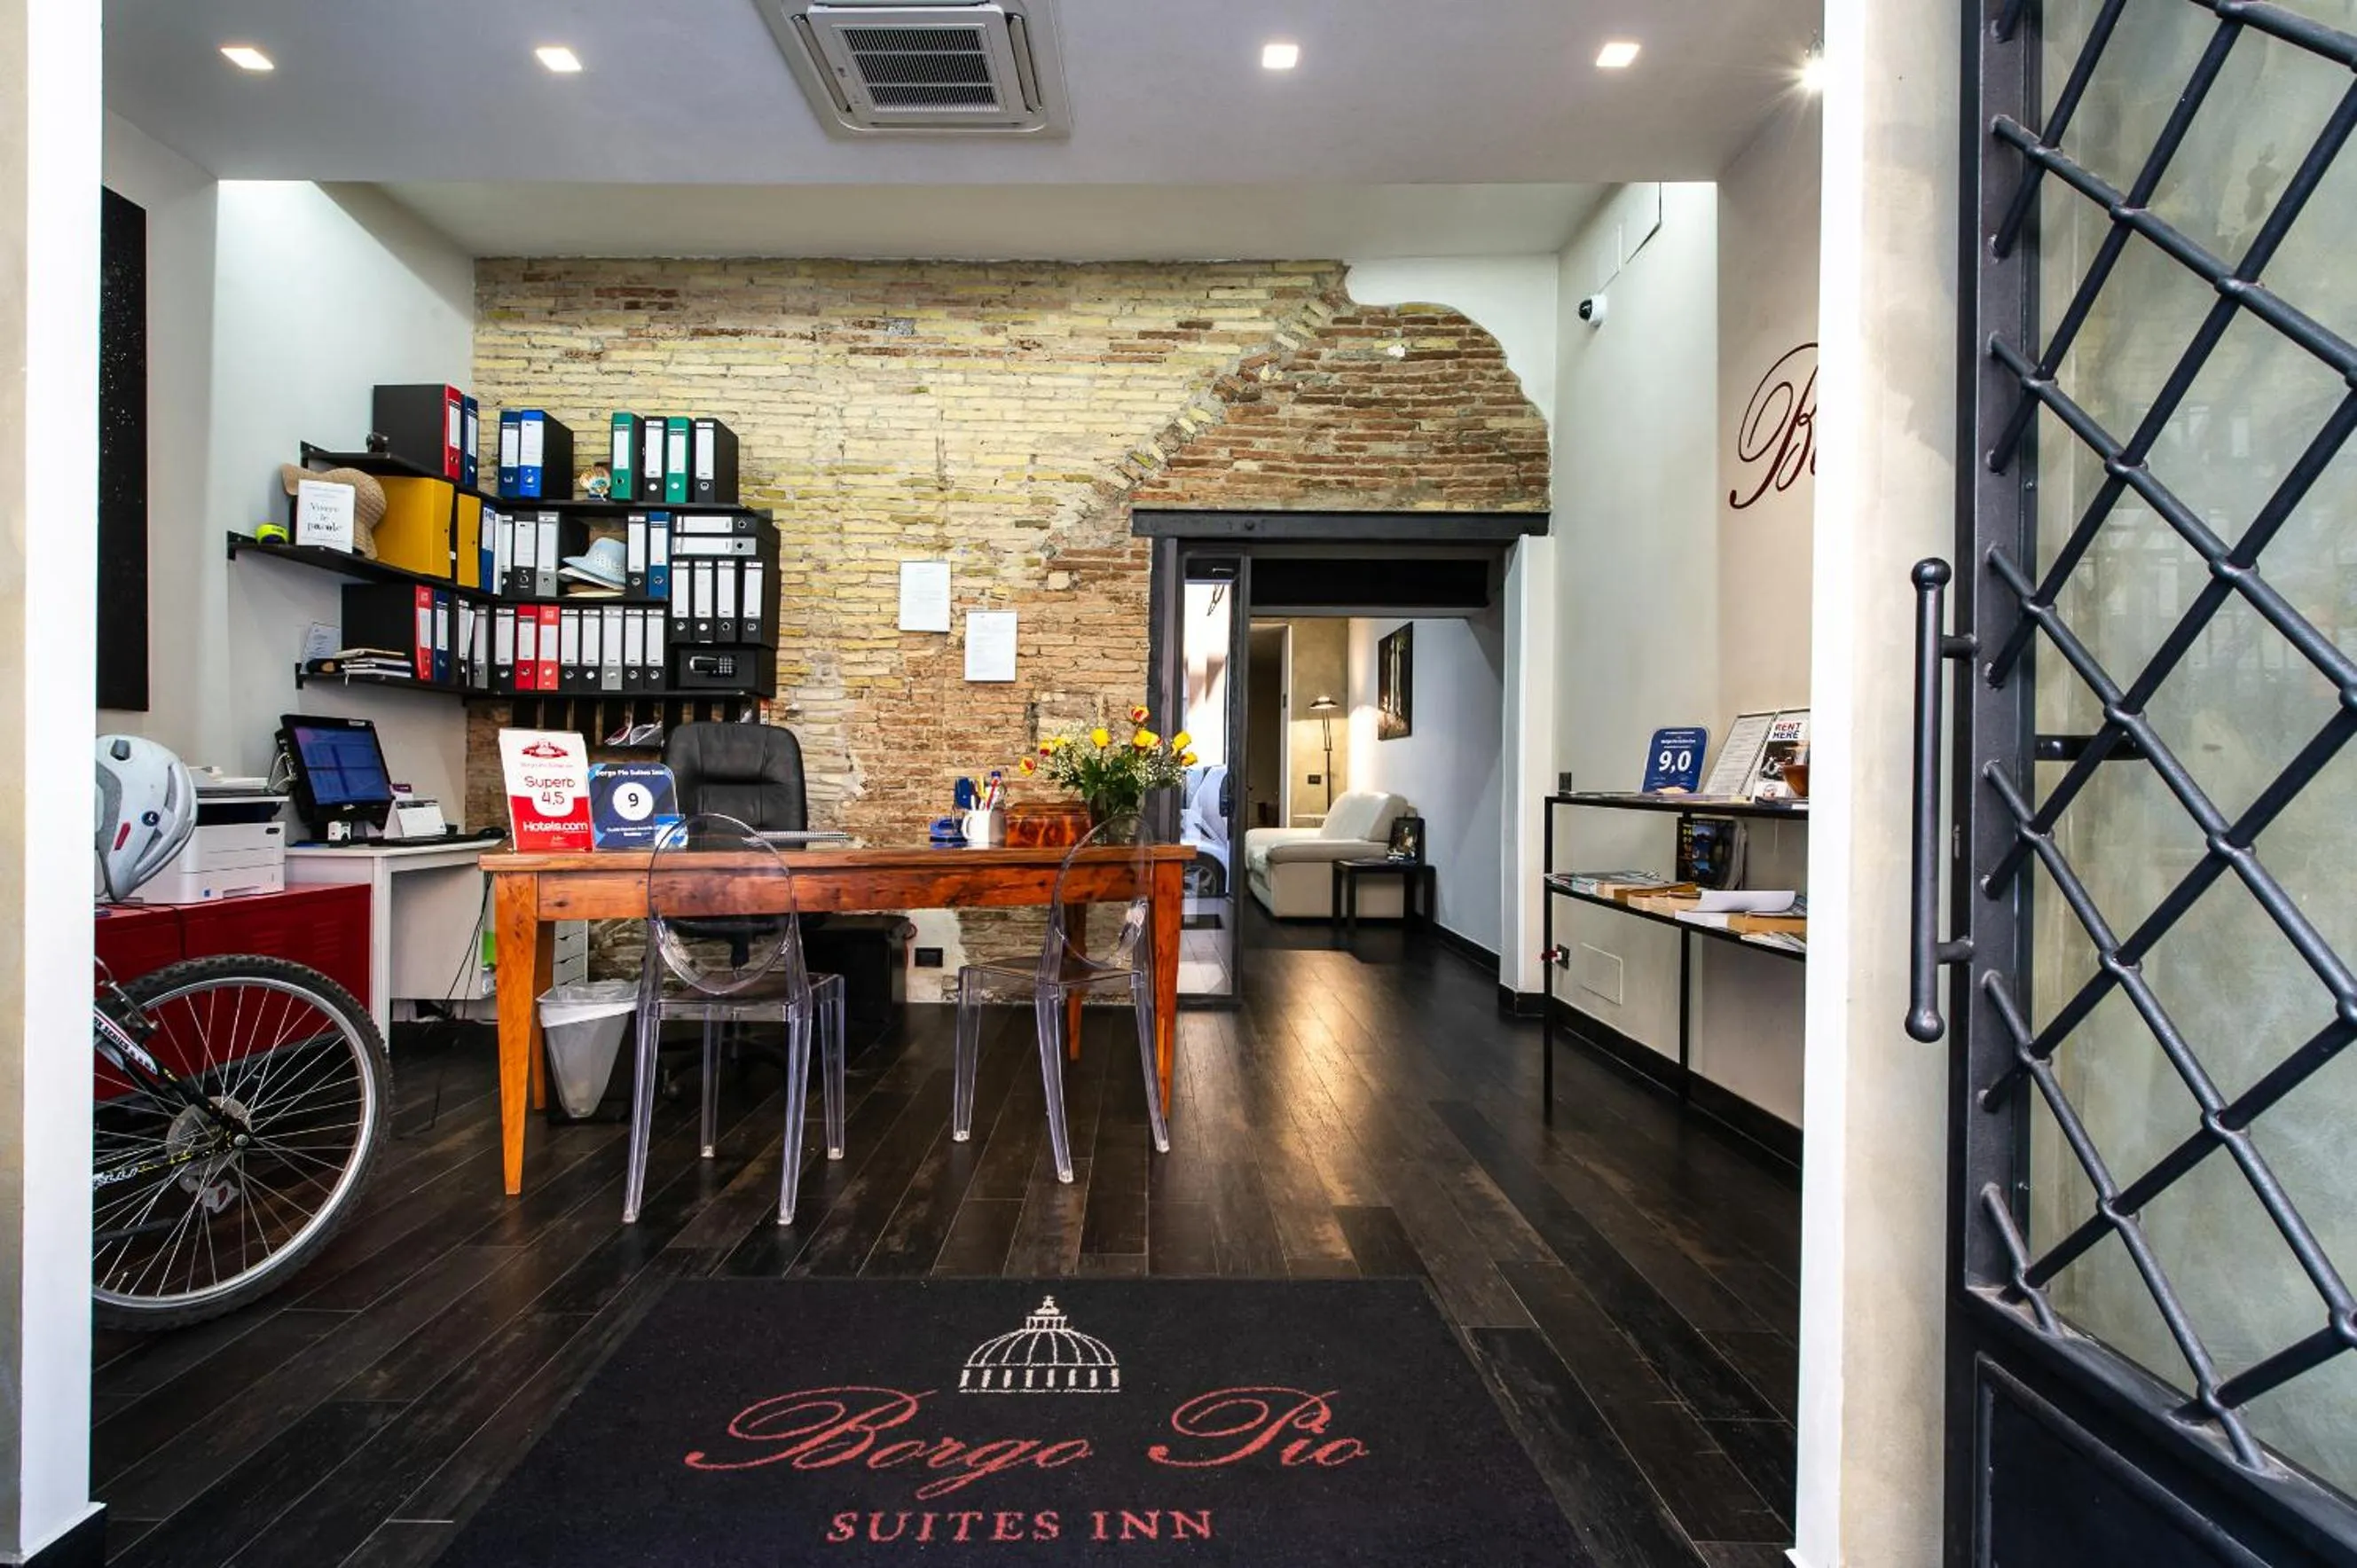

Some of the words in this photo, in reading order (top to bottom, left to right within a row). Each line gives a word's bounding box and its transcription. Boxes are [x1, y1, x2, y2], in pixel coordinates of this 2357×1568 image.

[1775, 722, 1803, 732] RENT
[1772, 731, 1799, 740] HERE
[1659, 750, 1692, 773] 9,0
[524, 775, 576, 788] Superb
[541, 791, 565, 805] 4.5
[628, 793, 639, 808] 9
[522, 821, 588, 832] Hotels.com
[685, 1386, 1093, 1501] Borgo
[1149, 1386, 1370, 1468] Pio
[827, 1511, 1061, 1541] SUITES
[1092, 1511, 1214, 1540] INN
